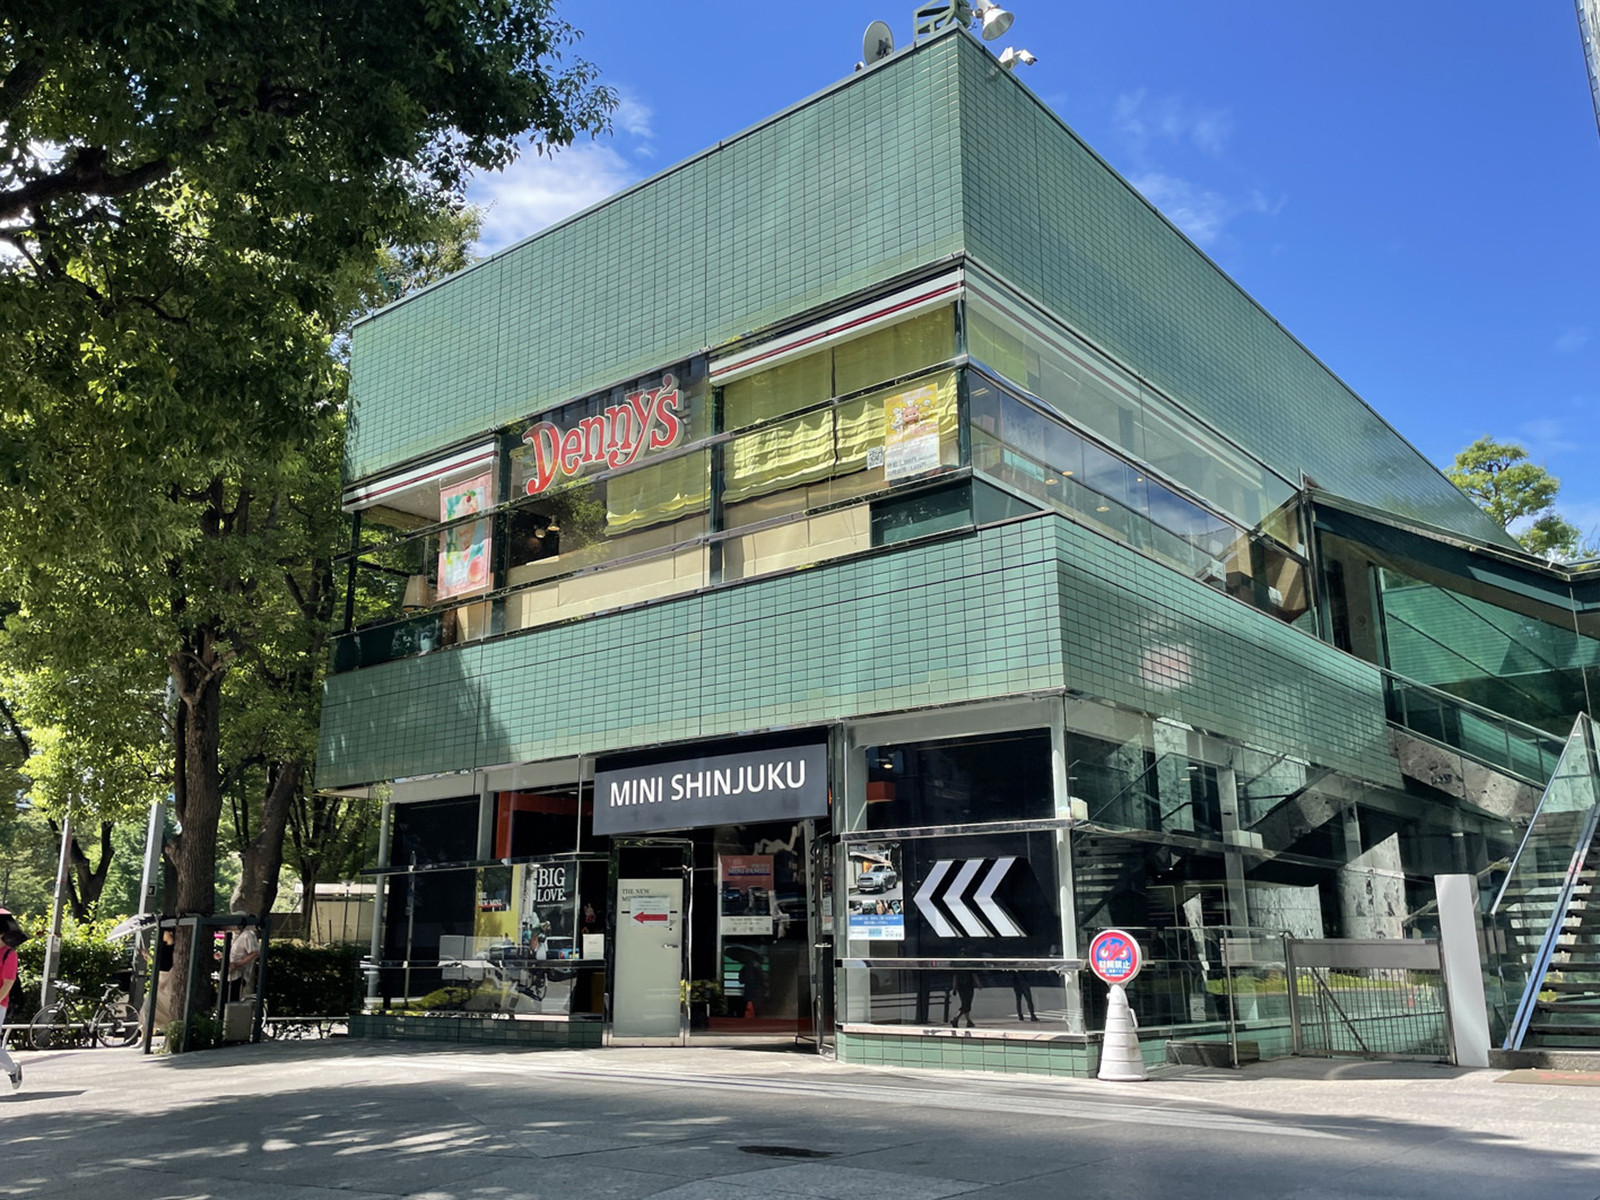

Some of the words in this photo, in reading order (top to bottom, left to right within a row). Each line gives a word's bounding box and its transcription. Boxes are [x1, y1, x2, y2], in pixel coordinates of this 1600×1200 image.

[522, 373, 682, 496] Denny's
[610, 776, 663, 808] MINI
[670, 759, 807, 802] SHINJUKU
[537, 867, 566, 888] BIG
